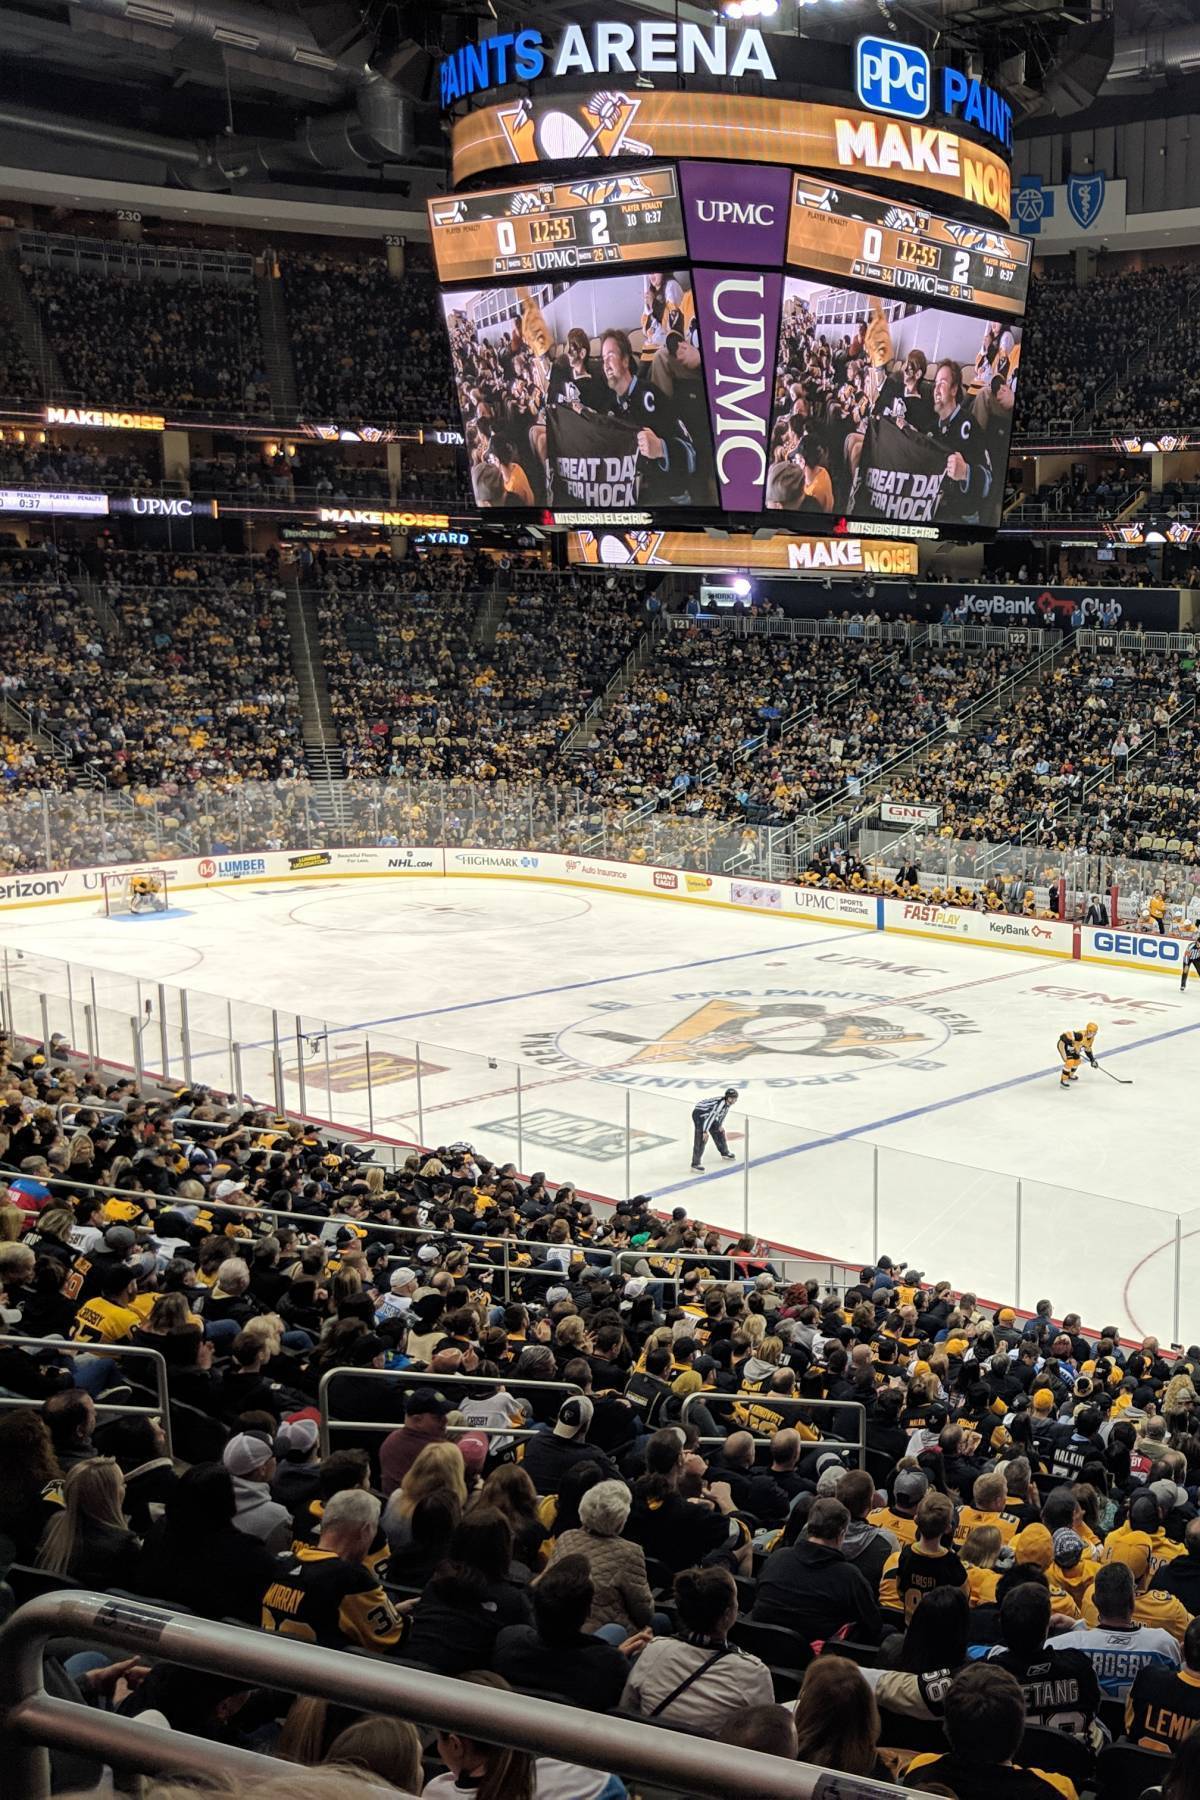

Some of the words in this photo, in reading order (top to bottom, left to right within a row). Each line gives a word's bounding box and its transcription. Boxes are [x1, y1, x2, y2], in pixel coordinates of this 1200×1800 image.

[440, 28, 545, 111] PAINTS
[555, 22, 777, 81] ARENA
[863, 47, 926, 105] PPG
[943, 65, 1014, 154] PAINT
[834, 118, 961, 178] MAKE
[117, 210, 141, 223] 230
[627, 213, 637, 227] 10
[696, 199, 775, 227] UPMC
[533, 219, 571, 243] 12:55
[589, 209, 611, 245] 2
[496, 221, 517, 256] 0
[863, 227, 882, 263] 0
[522, 257, 532, 269] 34
[537, 250, 577, 269] UPMC
[593, 248, 605, 261] 25
[900, 240, 937, 267] 12:55
[881, 268, 893, 282] 34
[952, 250, 971, 285] 2
[984, 265, 994, 278] 10
[1000, 270, 1013, 282] 0:37
[897, 271, 936, 293] UPMC
[950, 284, 960, 297] 25
[712, 274, 768, 487] UPMC
[435, 431, 464, 446] UPM
[568, 479, 584, 499] FOR
[584, 482, 637, 507] HOCK
[19, 499, 40, 509] 0:37
[132, 498, 193, 516] UPMC
[871, 490, 887, 511] FOR
[886, 494, 934, 522] HOCK
[554, 513, 602, 525] MITSUBISHI
[603, 513, 654, 525] ELECTRIC
[428, 532, 469, 545] YARD
[848, 522, 899, 536] MITSUBISHI
[900, 524, 940, 540] ELECTRIC
[787, 538, 862, 568] MAKE
[963, 594, 1036, 617] KeyBank
[674, 620, 690, 629] 121
[1009, 633, 1026, 645] 122
[889, 806, 930, 818] GNC
[219, 859, 265, 873] LUMBER
[388, 859, 432, 868] NHL.COM
[462, 854, 518, 868] HIGHMARK
[582, 865, 596, 875] Auto
[597, 868, 628, 879] Insurance
[0, 878, 59, 898] erizon
[656, 879, 675, 887] EAGLE
[795, 892, 835, 910] UPMC
[840, 898, 863, 907] SPORTS
[840, 905, 868, 915] MEDICINE
[904, 904, 938, 922] FAST
[935, 912, 960, 925] PLAY
[989, 922, 1030, 936] KeyBank
[1094, 932, 1180, 961] GEICO
[814, 952, 949, 977] UPMC
[1031, 985, 1182, 1013] GNC
[765, 988, 896, 1002] PAINTS
[902, 1001, 982, 1036] ARENA
[1054, 1448, 1085, 1468] MALKIN
[262, 1582, 304, 1615] MURRAY
[1092, 1651, 1153, 1679] ROSBY
[1023, 1678, 1079, 1704] ETANG
[1145, 1703, 1198, 1741] LEMI
